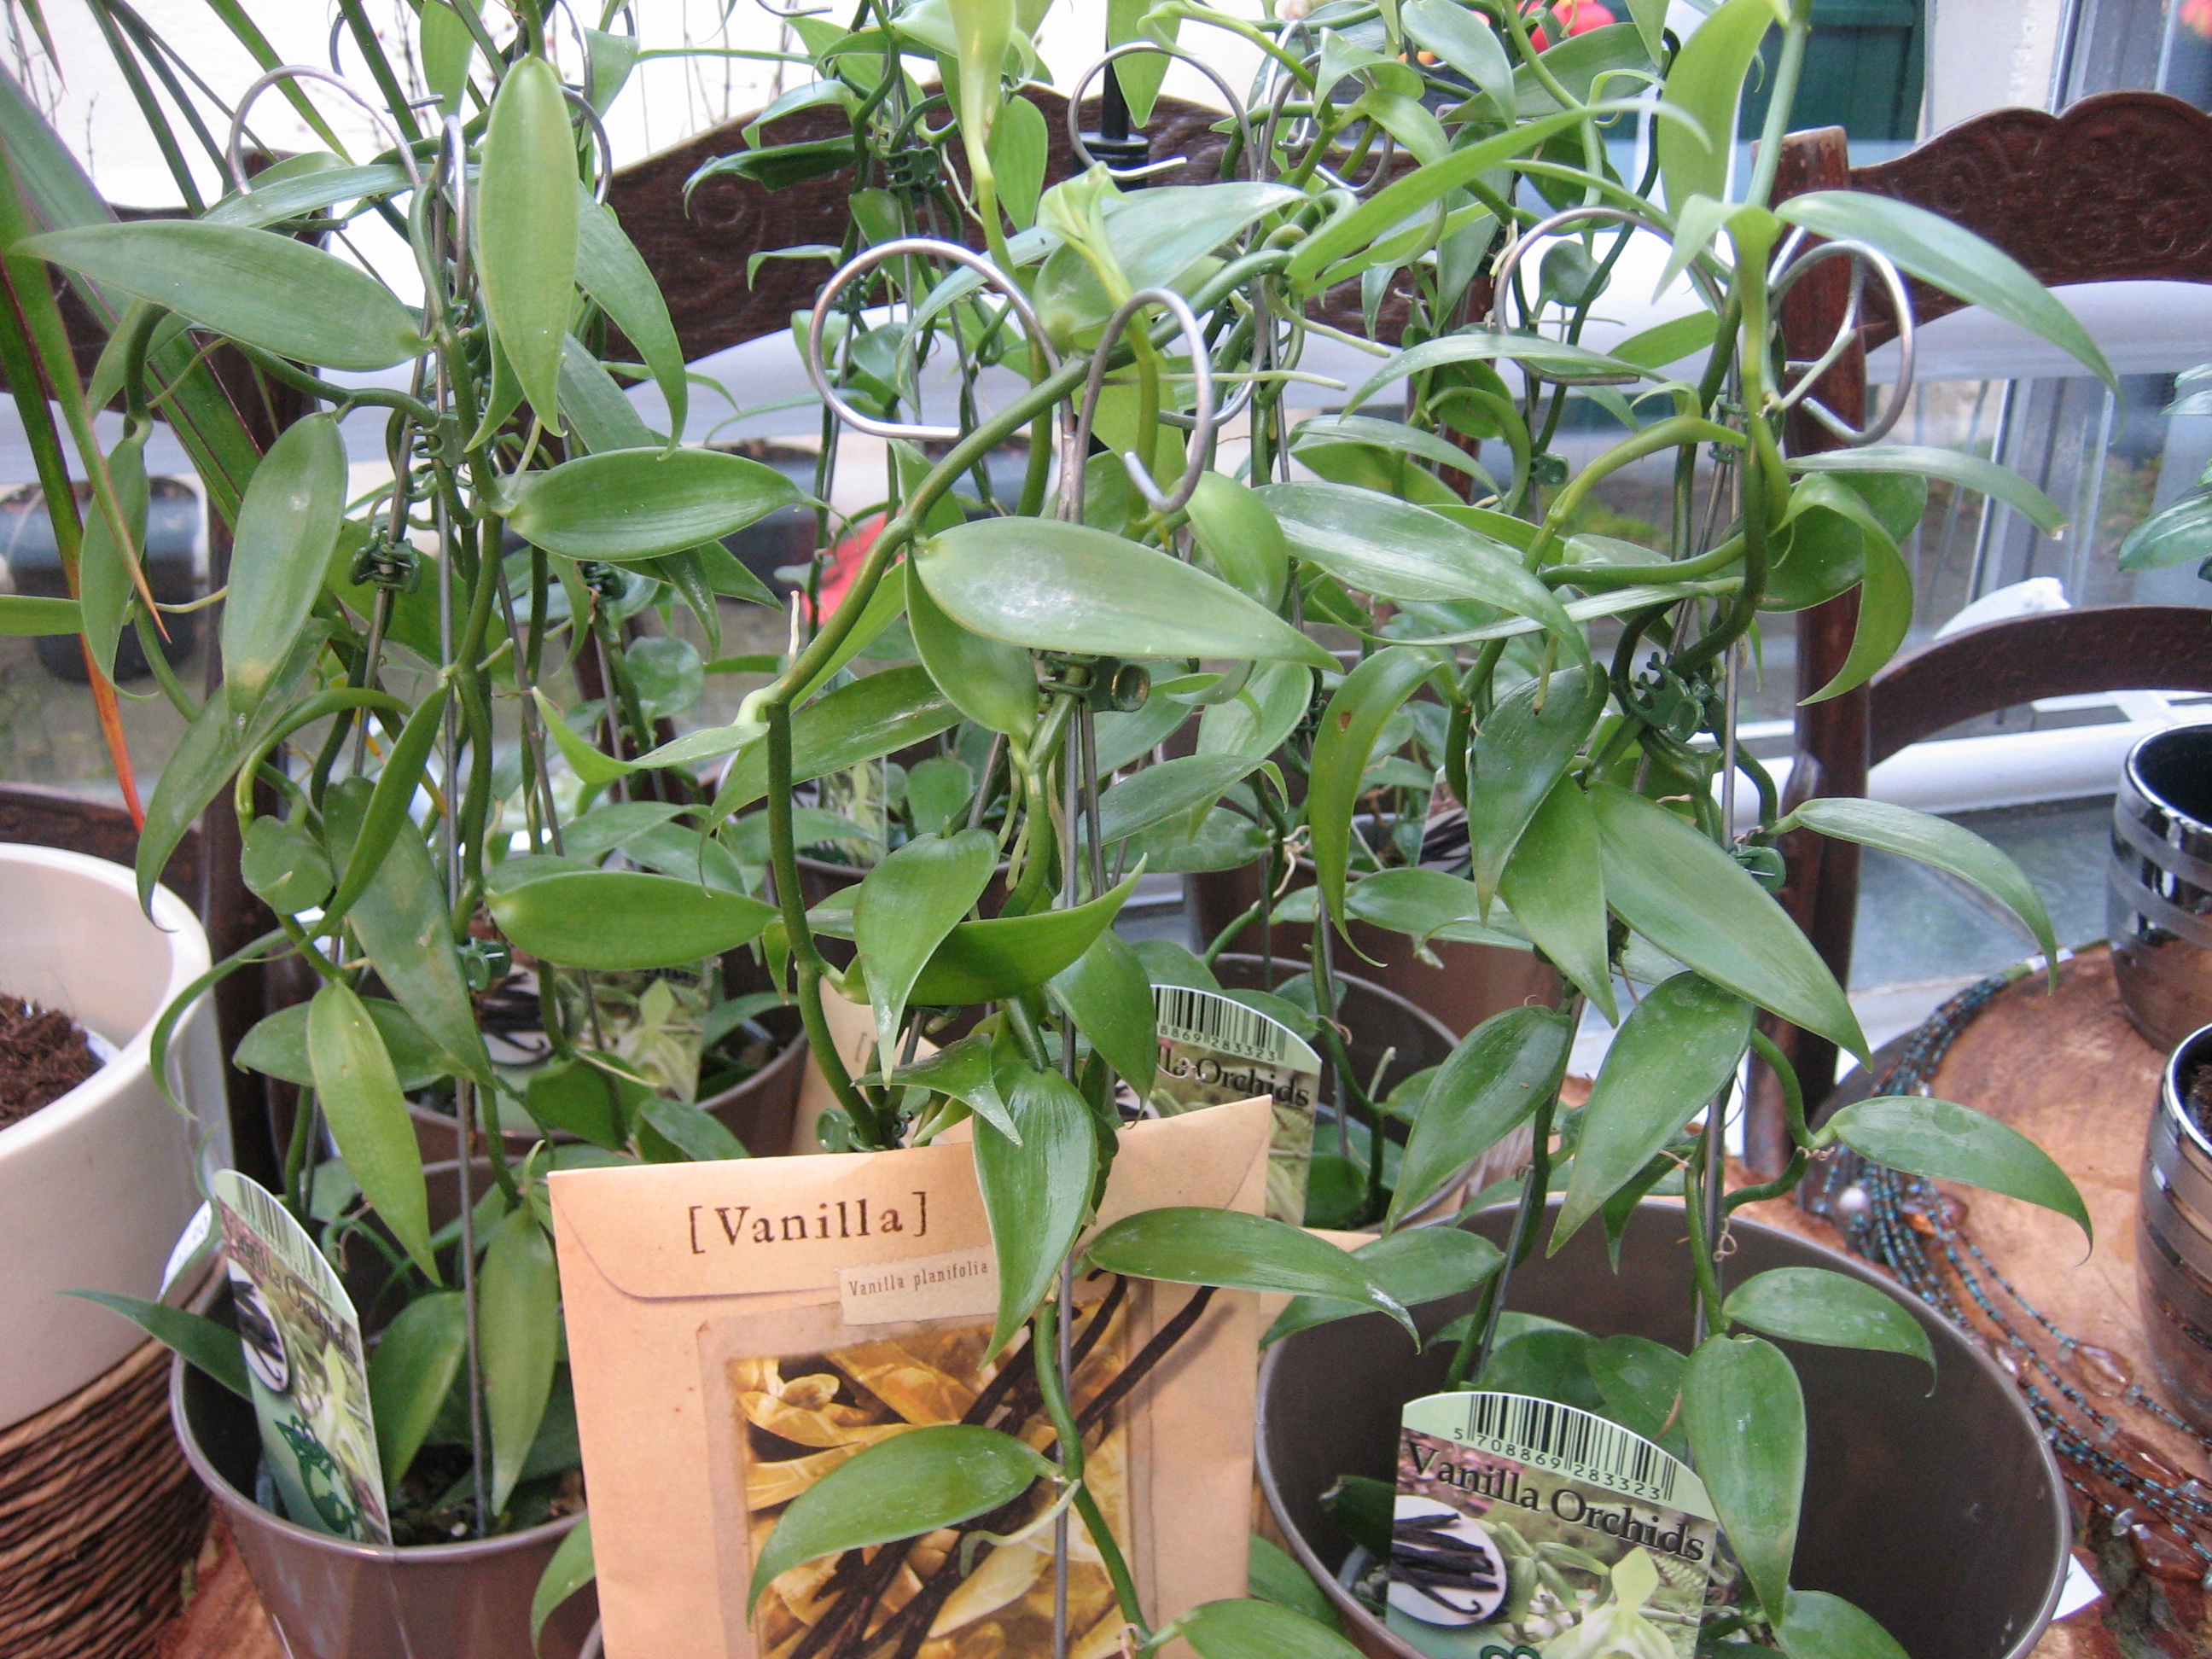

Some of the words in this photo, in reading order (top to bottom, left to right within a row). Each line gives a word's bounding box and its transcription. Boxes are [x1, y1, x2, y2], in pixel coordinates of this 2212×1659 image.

[1159, 1025, 1202, 1042] 8869
[1196, 1058, 1311, 1108] Orchids
[849, 1276, 905, 1296] Vanilla
[914, 1260, 988, 1290] planifolia
[1408, 1441, 1541, 1513] Vanilla
[1551, 1488, 1705, 1563] Orchids
